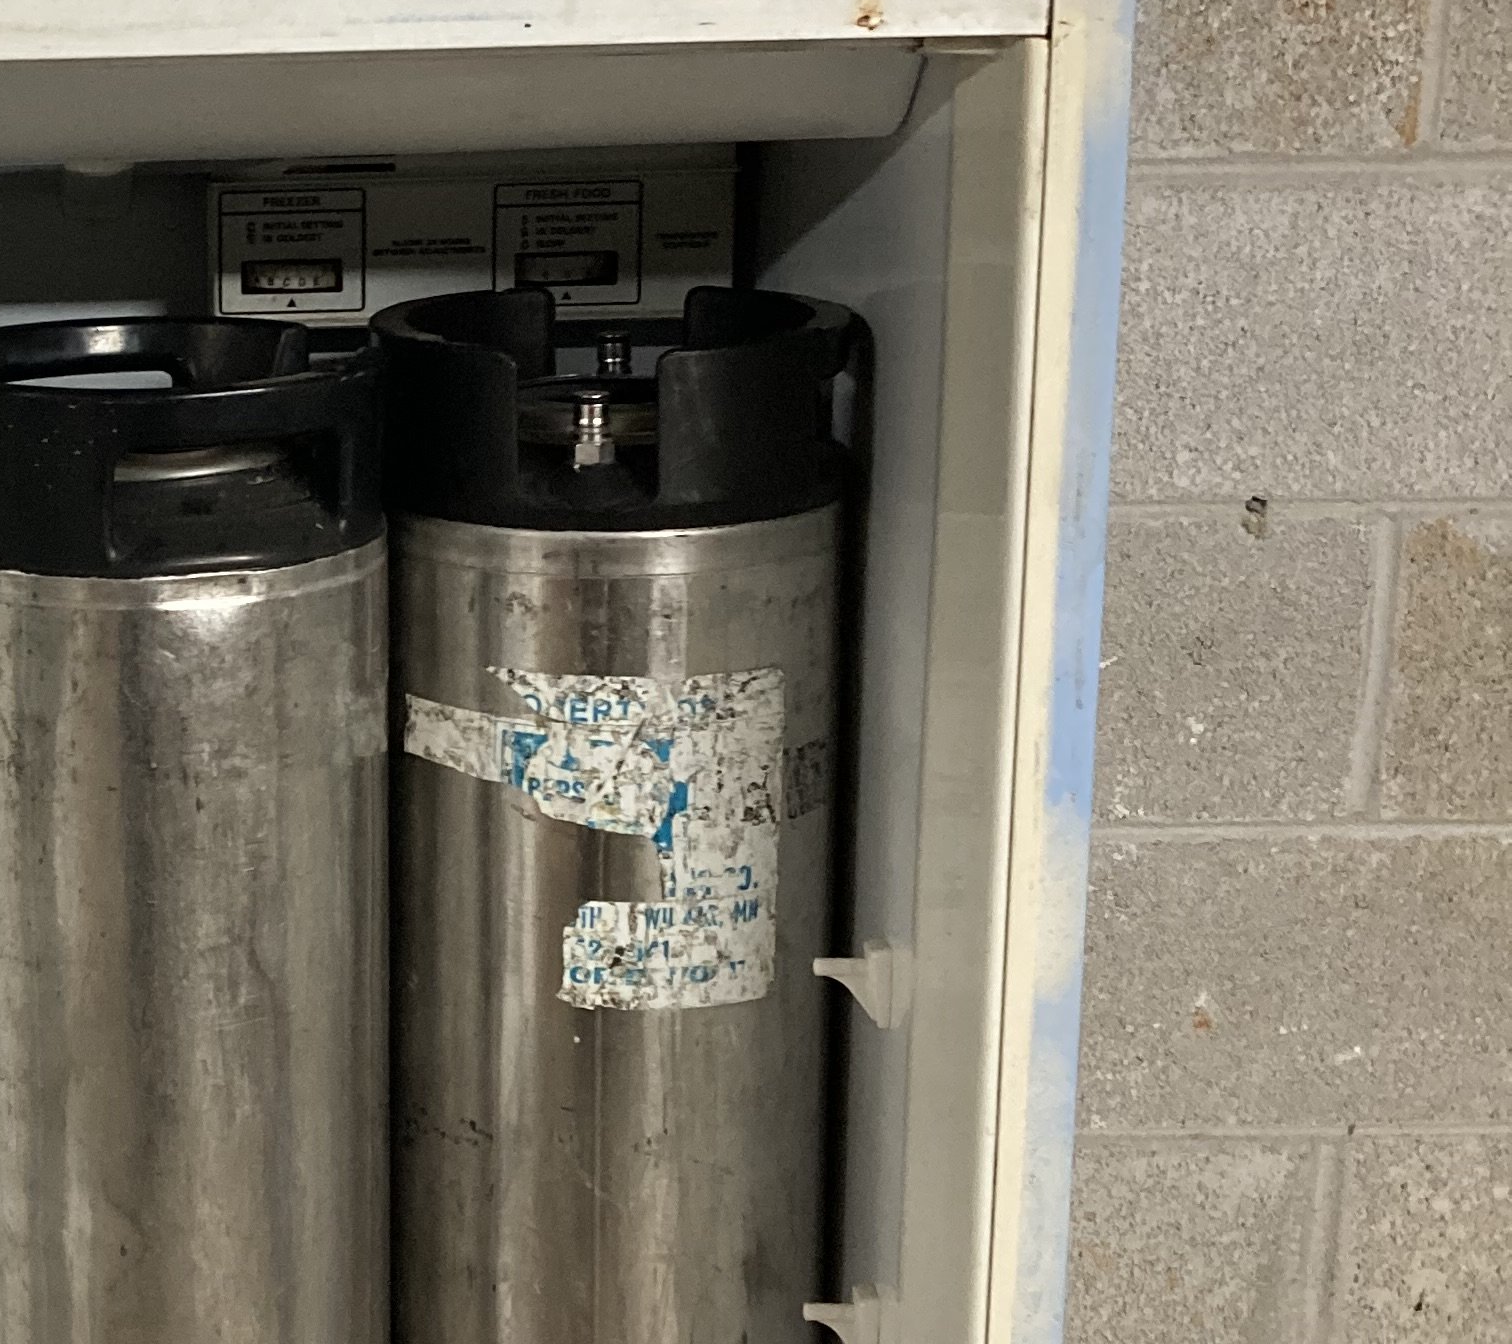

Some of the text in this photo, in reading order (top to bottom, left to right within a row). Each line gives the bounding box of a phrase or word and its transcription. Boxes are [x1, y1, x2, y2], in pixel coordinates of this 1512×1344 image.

[525, 187, 612, 201] FRESH FOOD
[262, 195, 322, 207] FREEZER
